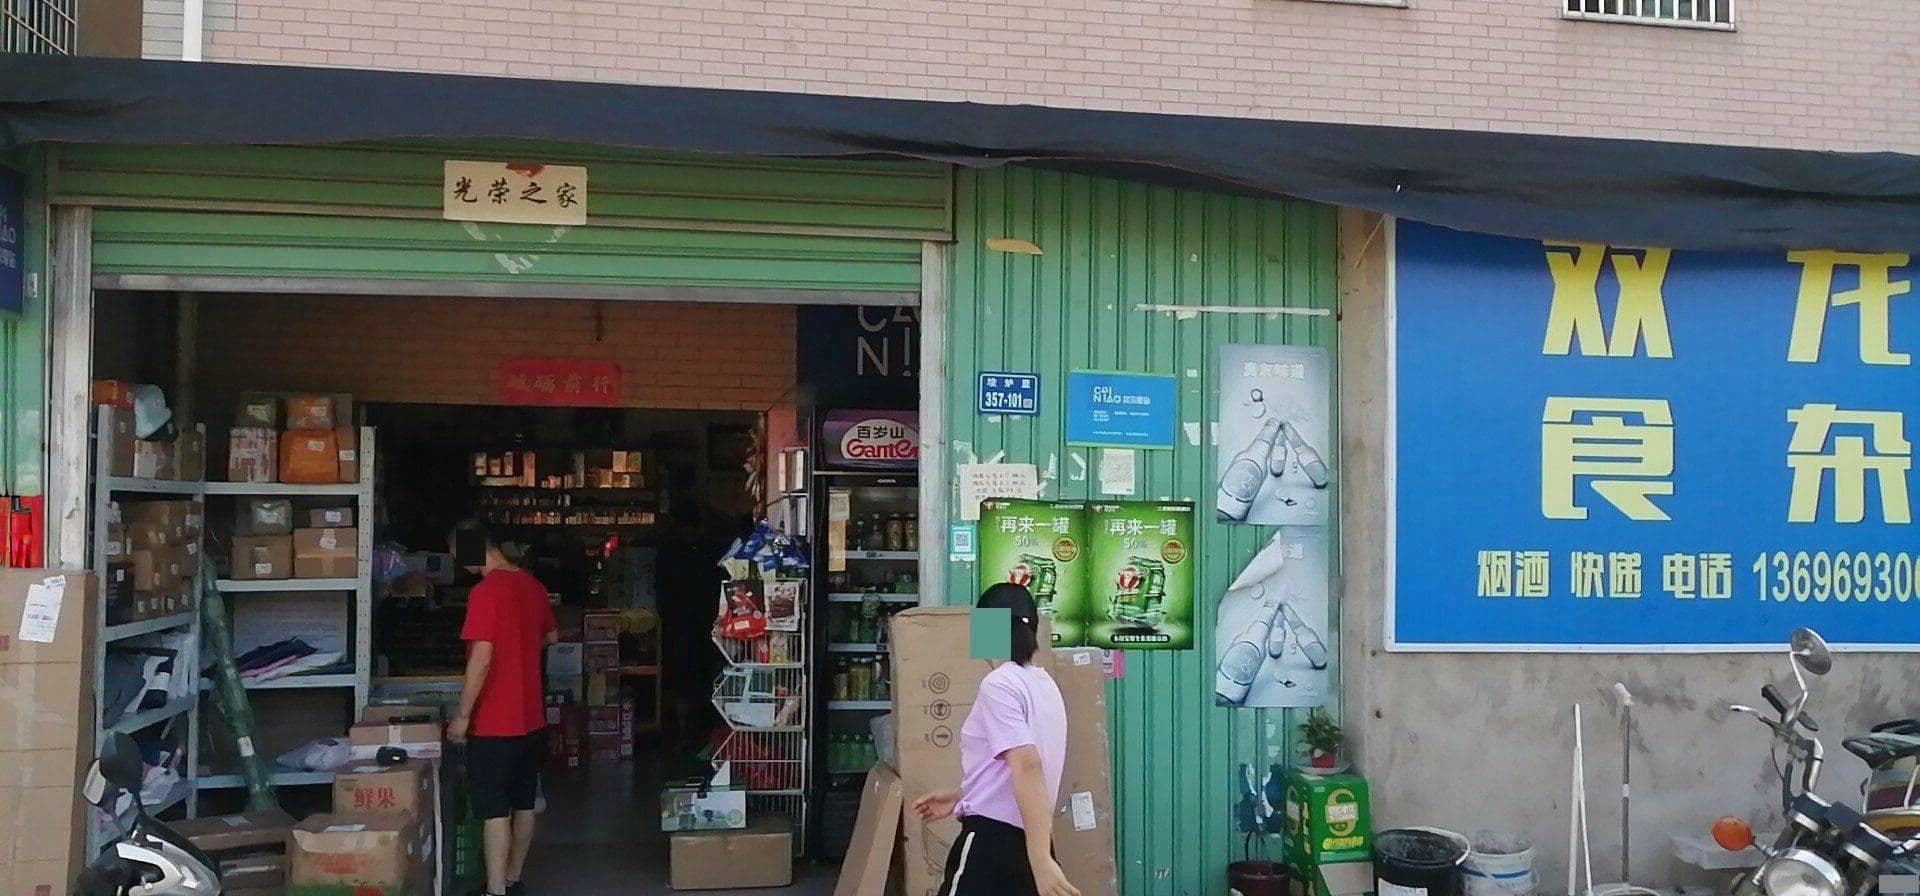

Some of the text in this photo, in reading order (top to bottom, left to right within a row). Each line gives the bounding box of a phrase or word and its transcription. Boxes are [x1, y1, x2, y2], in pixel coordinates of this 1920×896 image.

[453, 176, 578, 208] 光荣之家
[985, 391, 1022, 408] 357-101
[857, 425, 904, 439] 百岁山
[1542, 396, 1911, 523] 食杂
[1001, 516, 1070, 534] 再来一罐
[1110, 518, 1178, 536] 再来一罐
[1477, 551, 1920, 602] 烟酒 快递 电话 13696930
[353, 786, 394, 809] 鲜果
